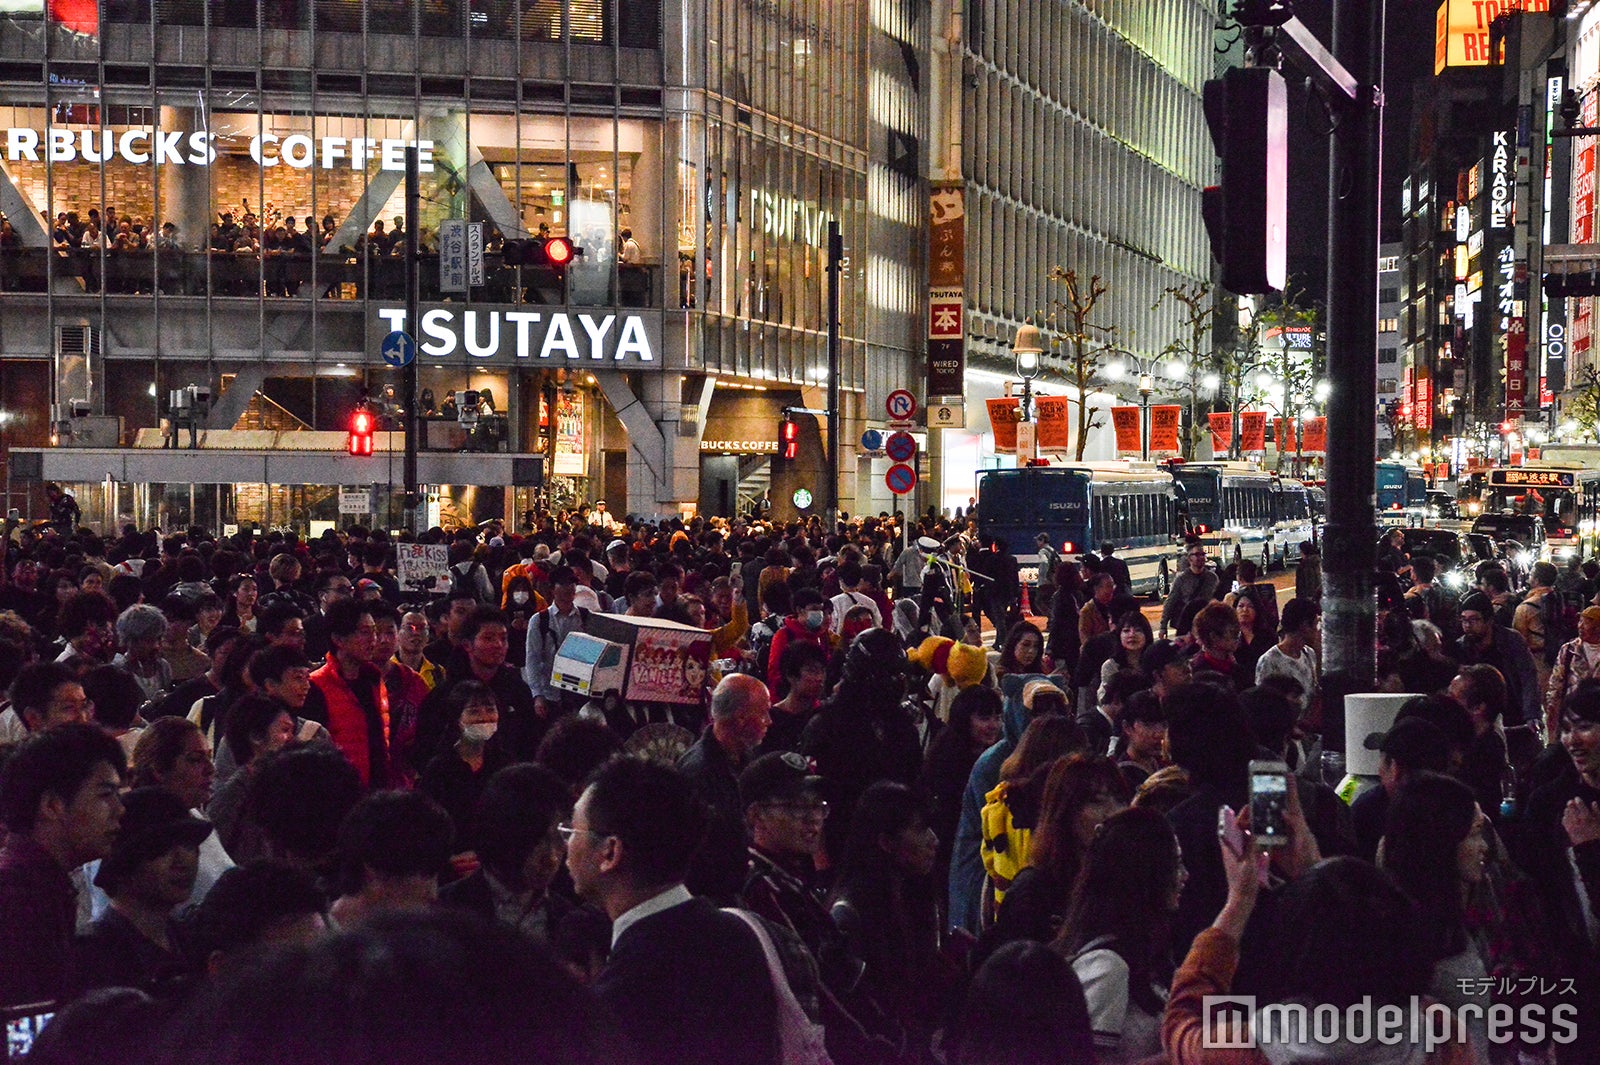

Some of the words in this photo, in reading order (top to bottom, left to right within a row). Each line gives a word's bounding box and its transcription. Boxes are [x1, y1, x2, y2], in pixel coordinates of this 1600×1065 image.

[0, 127, 216, 165] RBUCKS
[250, 133, 435, 172] COFFEE
[1492, 131, 1508, 228] KARAOKE
[451, 224, 462, 285] 渋谷駅前
[379, 307, 654, 361] TSUTAYA
[934, 307, 957, 332] 本
[933, 360, 959, 368] WIRED
[698, 440, 739, 450] BUCKS
[1049, 502, 1081, 510] ISUZU
